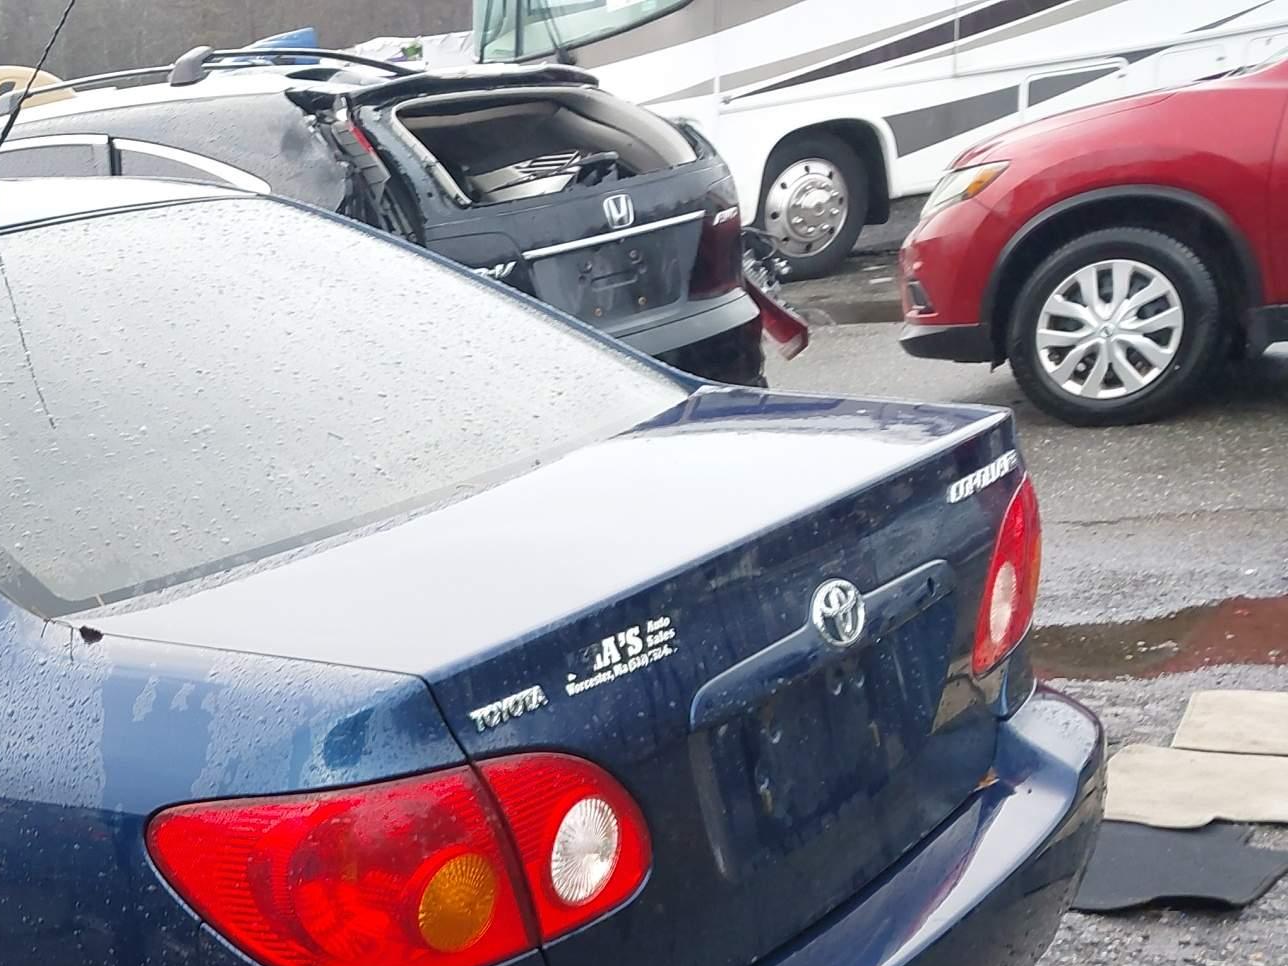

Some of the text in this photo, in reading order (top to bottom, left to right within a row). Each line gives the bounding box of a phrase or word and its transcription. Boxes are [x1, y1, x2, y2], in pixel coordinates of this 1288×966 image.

[647, 616, 671, 633] Auto
[646, 628, 676, 648] Sales
[469, 684, 549, 733] TOYOTA
